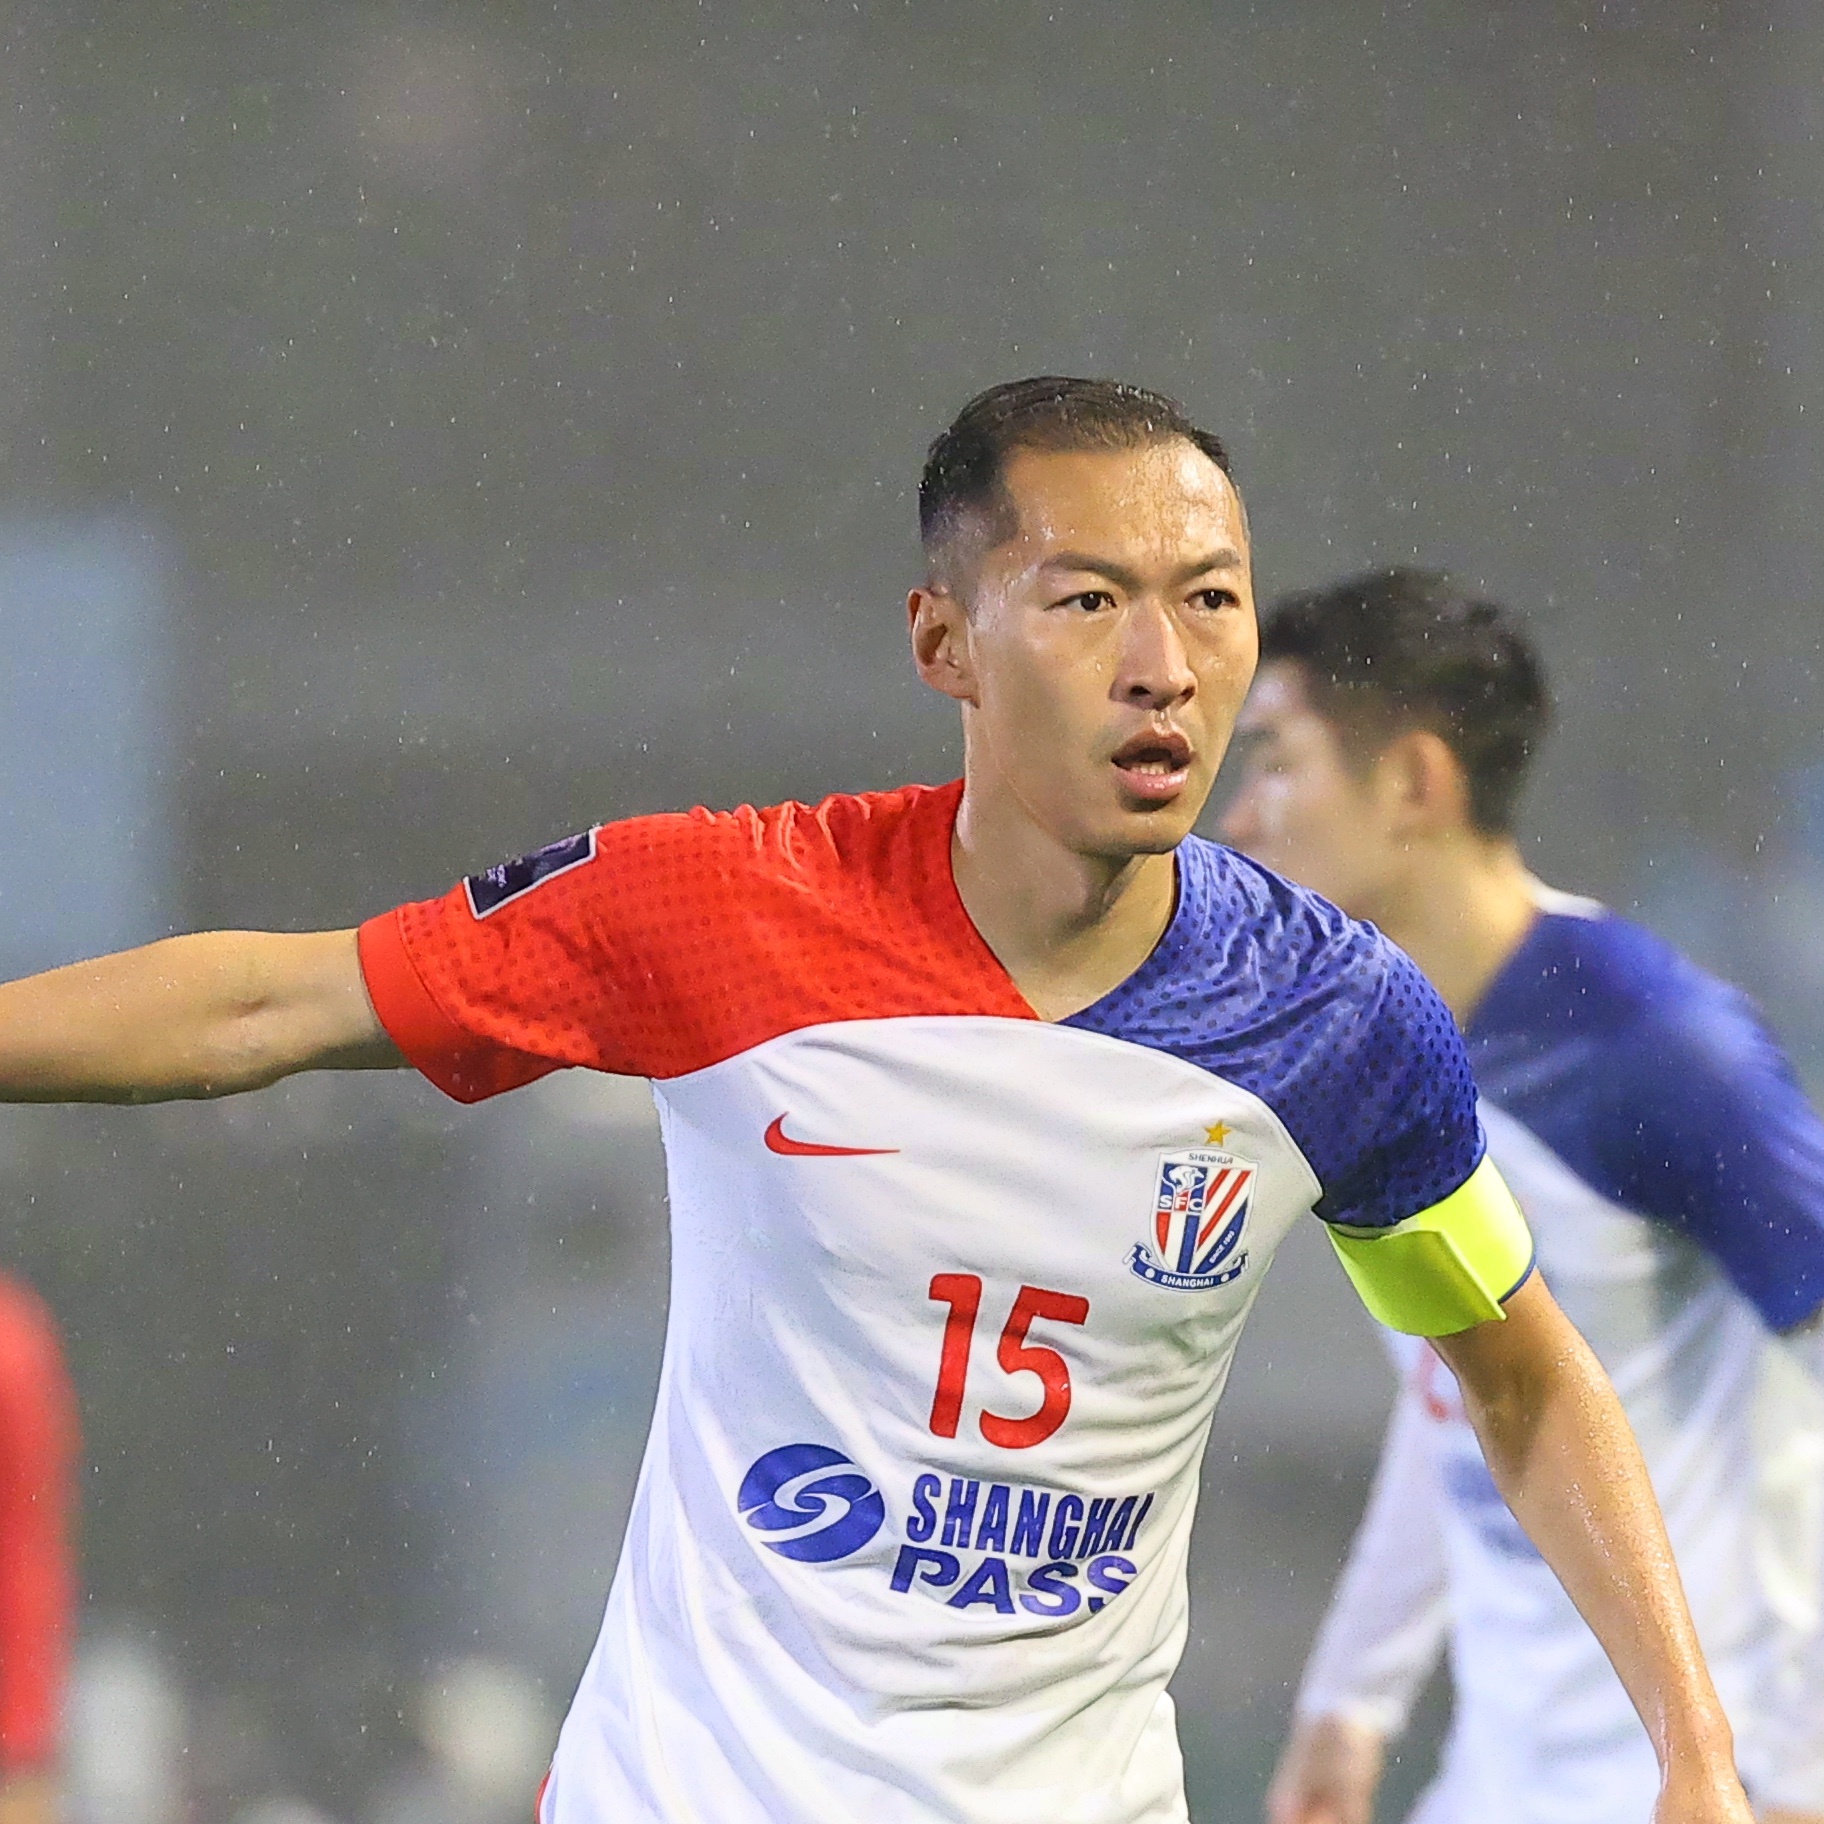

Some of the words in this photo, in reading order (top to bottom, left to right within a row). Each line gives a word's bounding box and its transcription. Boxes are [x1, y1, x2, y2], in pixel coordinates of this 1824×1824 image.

[1189, 1153, 1233, 1164] SHENHUA
[1159, 1195, 1202, 1211] SFC
[1160, 1274, 1214, 1288] SHANGHAI
[928, 1272, 1090, 1450] 15
[905, 1472, 1156, 1561] SHANGHAI
[889, 1543, 1138, 1617] PASS
